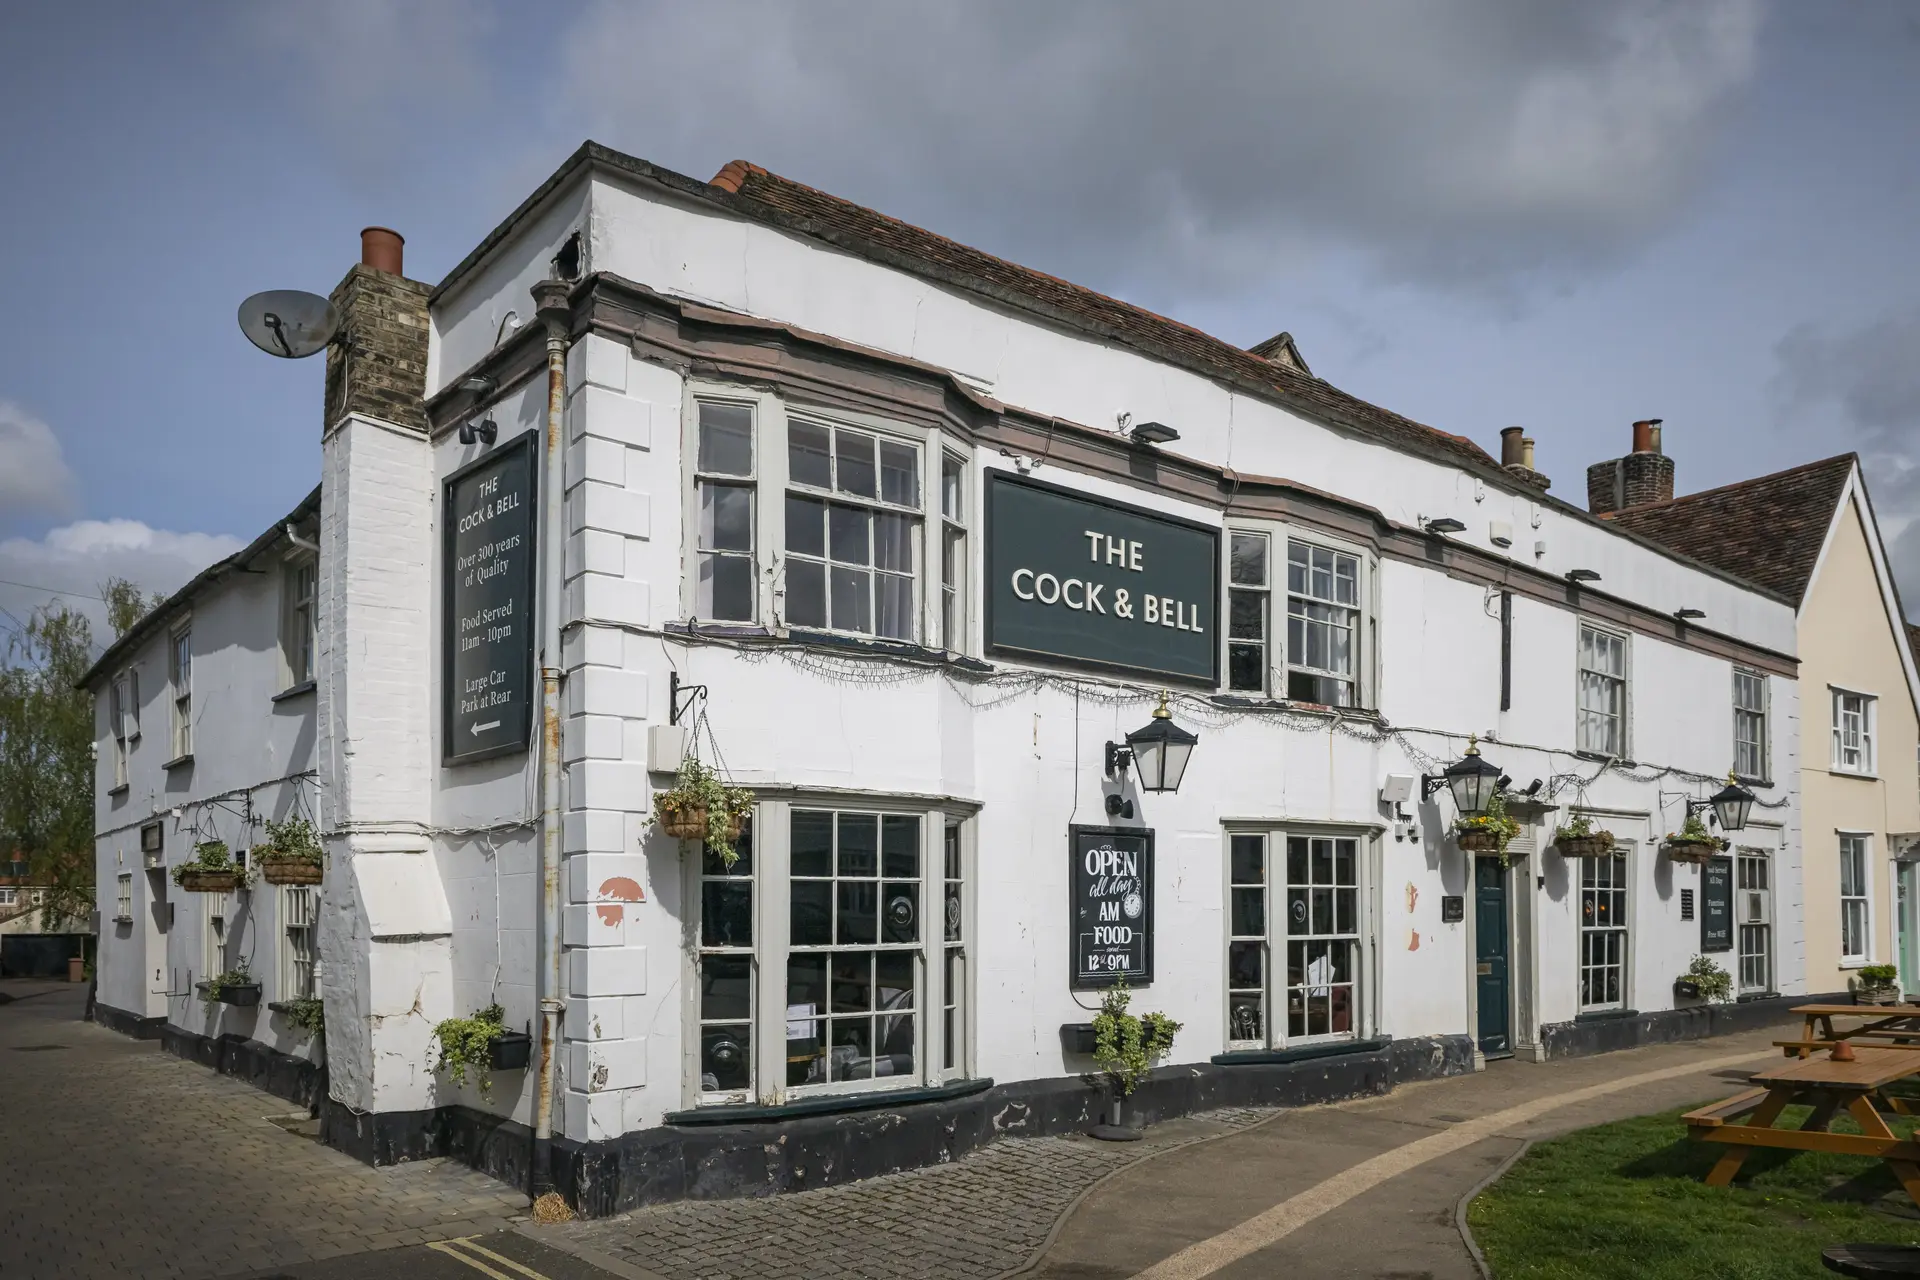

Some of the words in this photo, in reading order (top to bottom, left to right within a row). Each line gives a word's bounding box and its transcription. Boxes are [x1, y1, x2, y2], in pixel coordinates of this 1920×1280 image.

[479, 476, 498, 499] THE
[460, 507, 485, 534] COCK
[487, 504, 494, 520] &
[496, 491, 520, 515] BELL
[458, 553, 476, 572] Over
[478, 543, 493, 563] 300
[495, 534, 520, 558] years
[1084, 530, 1144, 572] THE
[465, 569, 474, 588] of
[477, 558, 509, 585] Quality
[1011, 568, 1107, 615] COCK
[1113, 588, 1134, 620] &
[1143, 593, 1204, 633] BELL
[461, 610, 480, 633] Food
[482, 598, 513, 624] Served
[461, 635, 480, 652] 11am
[488, 624, 511, 644] 10pm
[465, 676, 488, 693] Large
[490, 670, 506, 686] Car
[461, 695, 478, 714] Park
[480, 695, 488, 709] at
[490, 690, 512, 706] Rear
[1085, 849, 1138, 877] OPEN
[1089, 876, 1109, 897] all
[1109, 874, 1133, 901] day
[1099, 901, 1120, 921] AM
[1093, 926, 1132, 945] FOOD
[1088, 954, 1100, 971] 12
